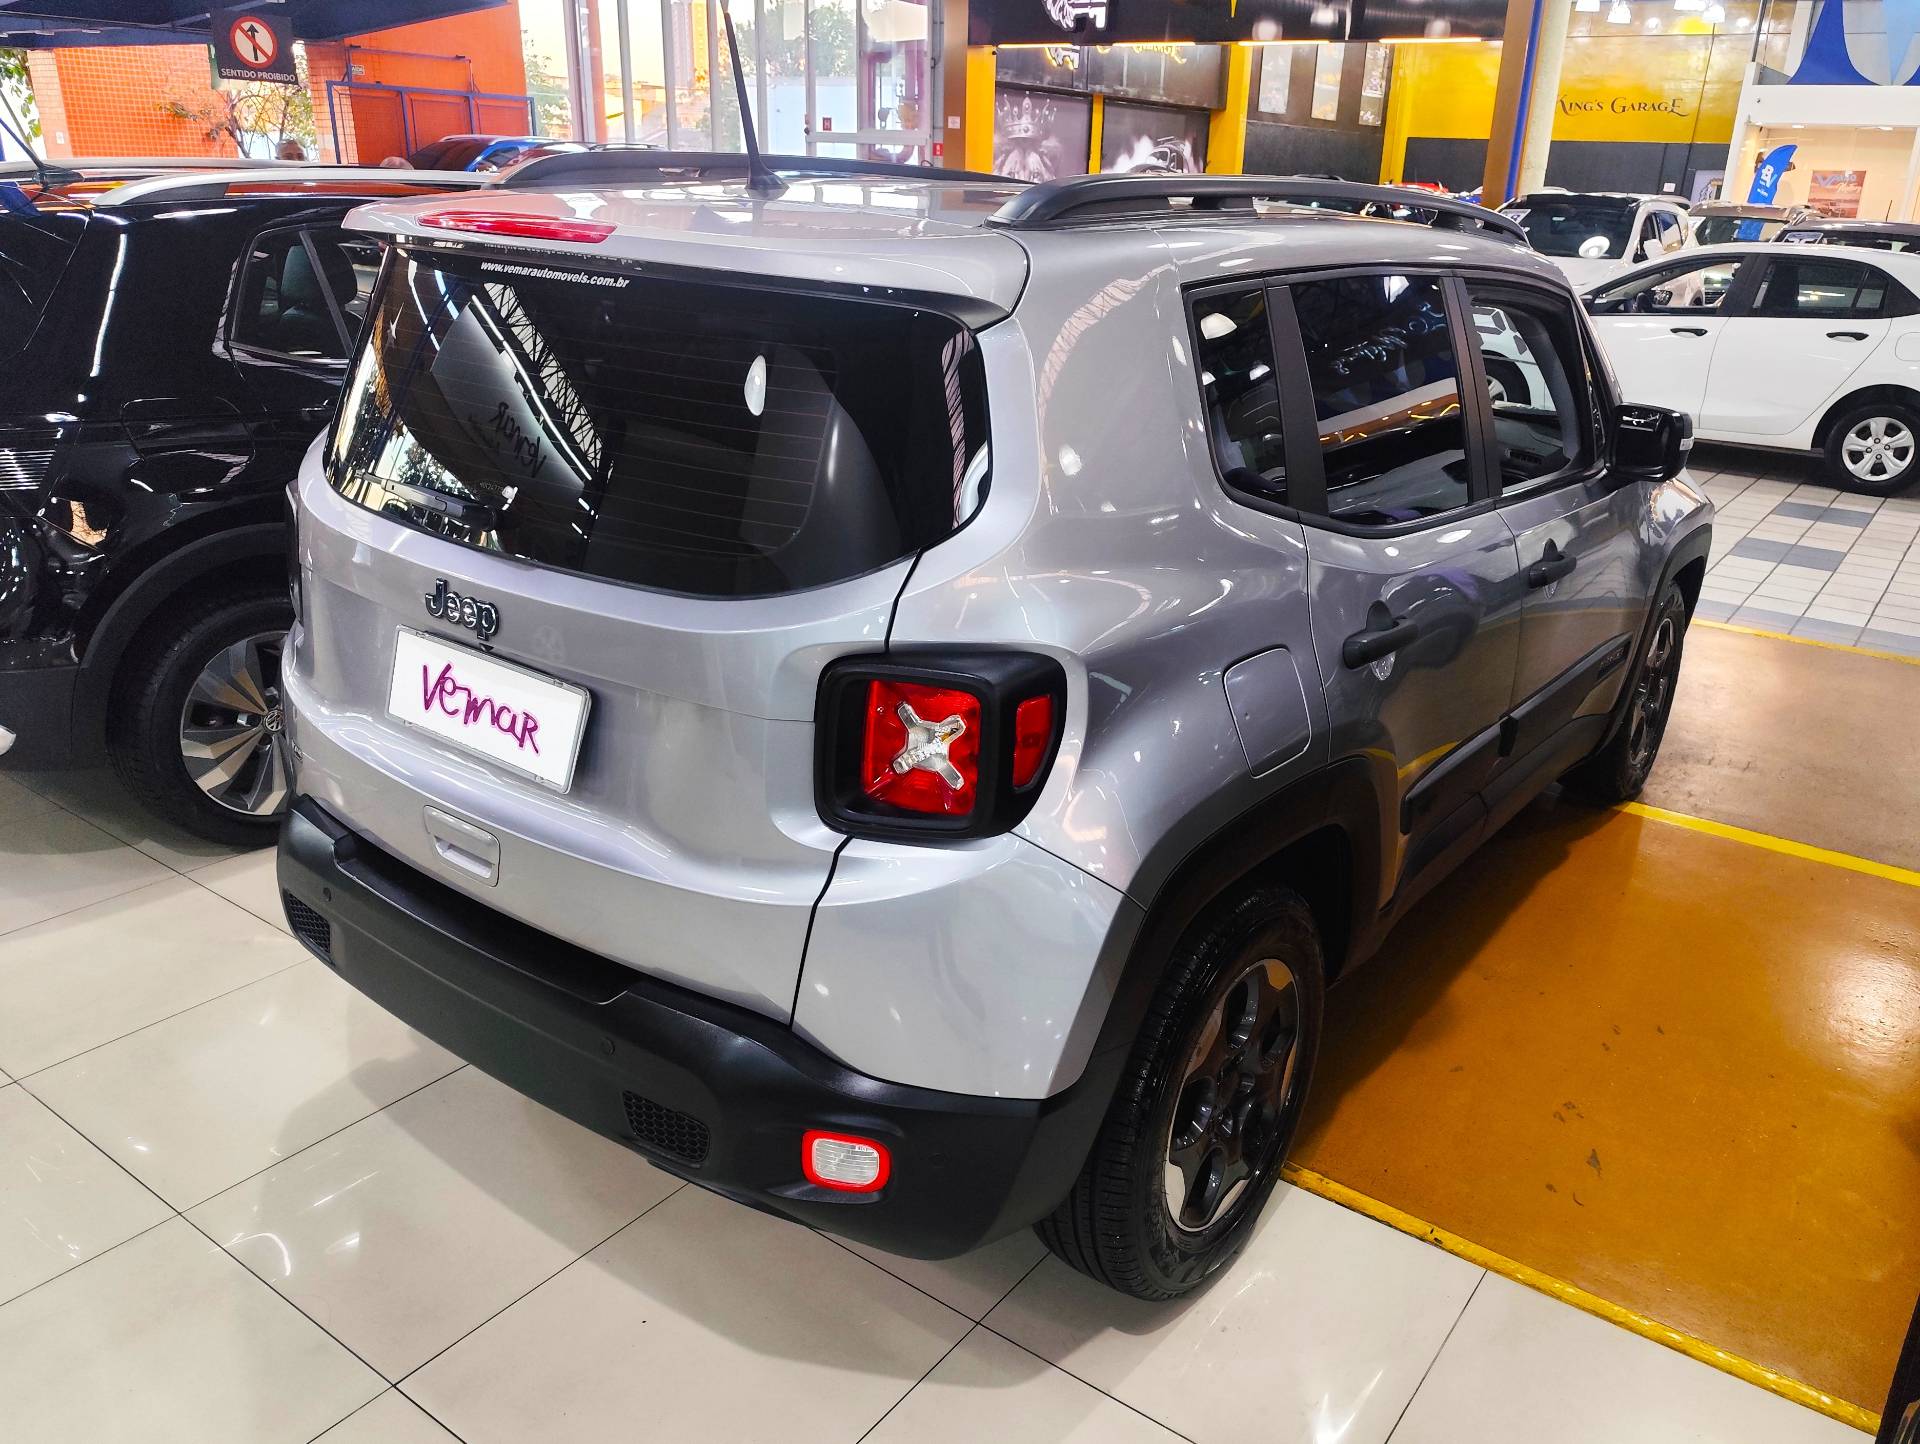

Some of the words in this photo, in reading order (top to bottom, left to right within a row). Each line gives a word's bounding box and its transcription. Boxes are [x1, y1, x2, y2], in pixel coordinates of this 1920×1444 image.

[221, 68, 256, 79] SENTIDO
[258, 71, 296, 82] PROIBIDO
[425, 577, 500, 641] Jeep
